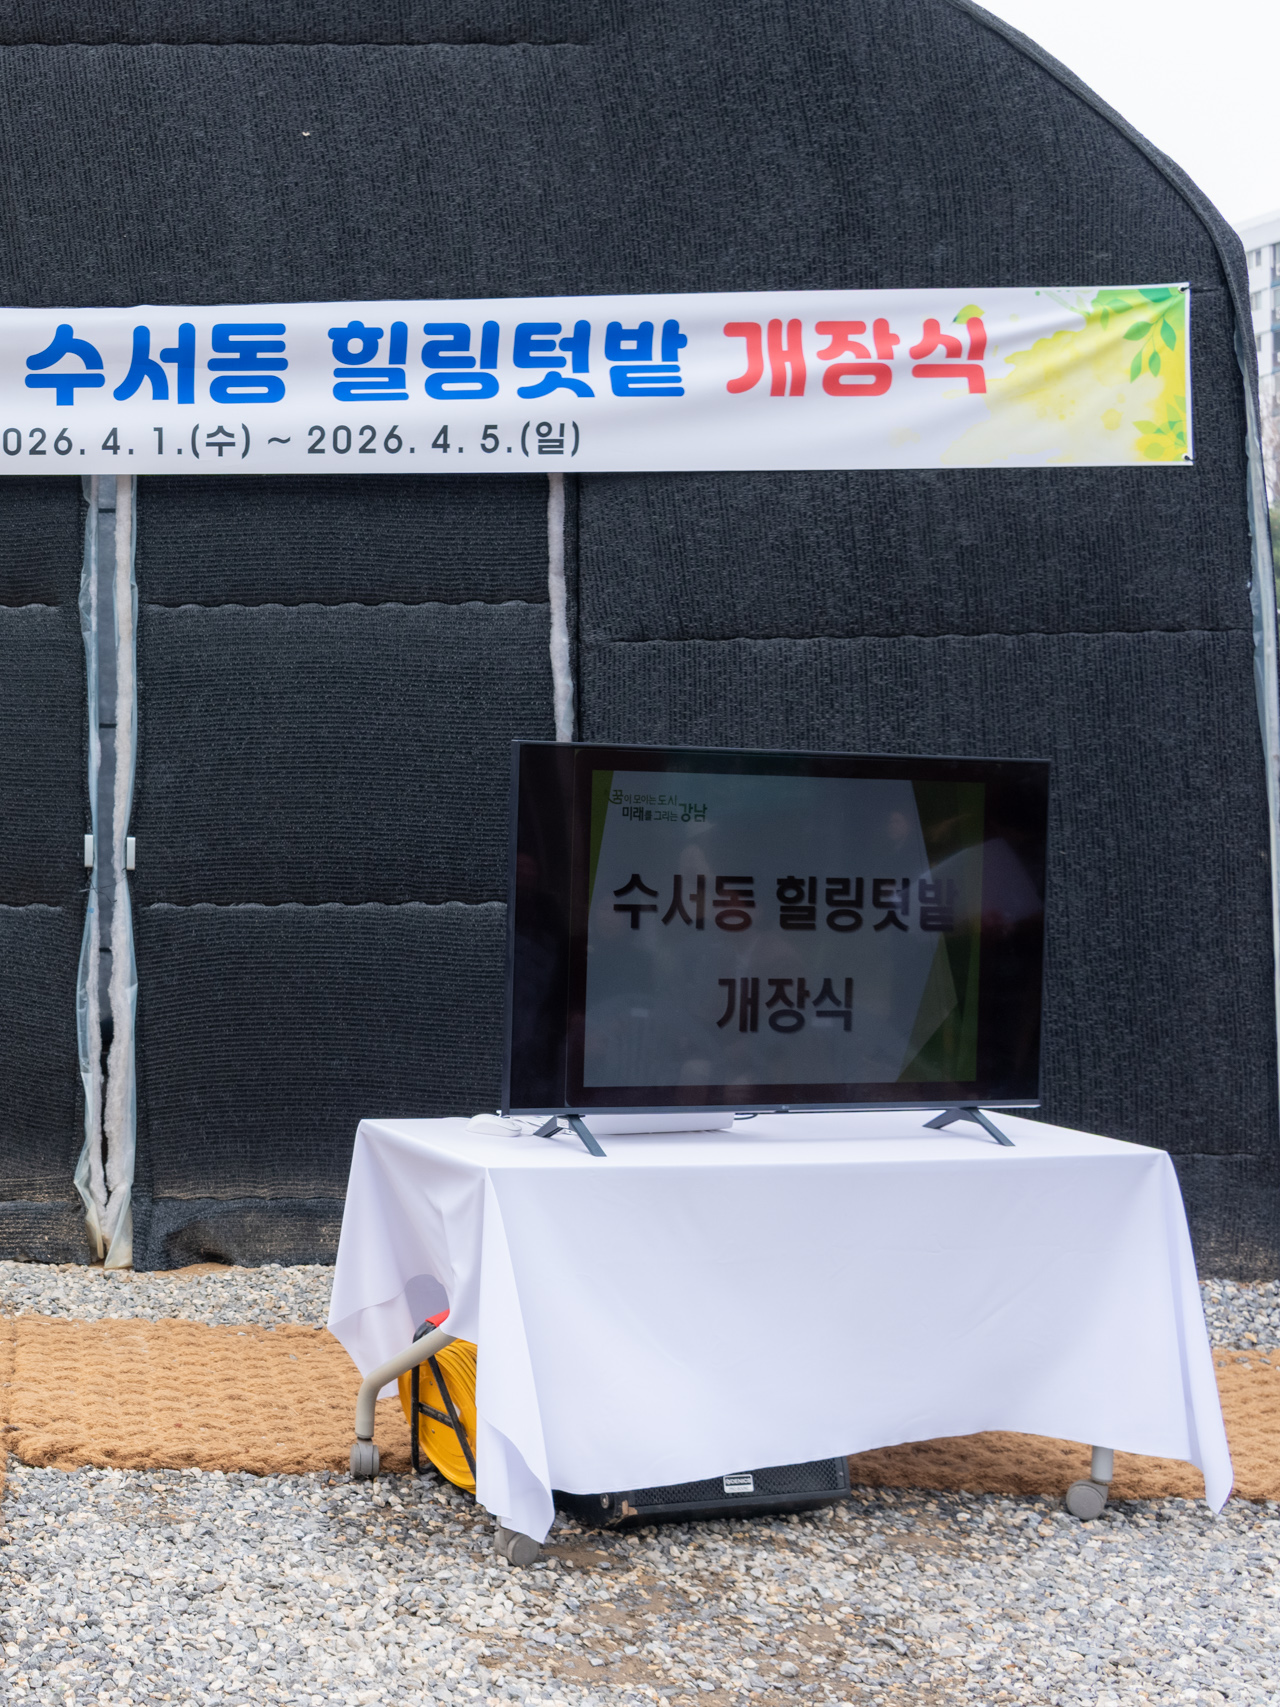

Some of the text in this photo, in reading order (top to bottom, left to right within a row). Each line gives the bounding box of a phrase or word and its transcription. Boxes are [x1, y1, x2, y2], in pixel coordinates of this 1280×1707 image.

[24, 322, 289, 407] 수서동
[327, 318, 688, 402] 힐링텃밭
[723, 316, 988, 397] 개장식
[101, 427, 134, 455] 4.
[153, 423, 251, 460] 1.(수)
[267, 436, 291, 445] ~
[307, 424, 415, 455] 2026.
[431, 424, 464, 454] 4.
[480, 420, 580, 458] 5.(일)
[610, 789, 632, 804] 꿈이
[658, 795, 678, 806] 도시
[622, 803, 708, 822] 미래를 그리는 강남
[612, 873, 960, 932] 수서동 힐링텃밭
[715, 977, 854, 1033] 개장식
